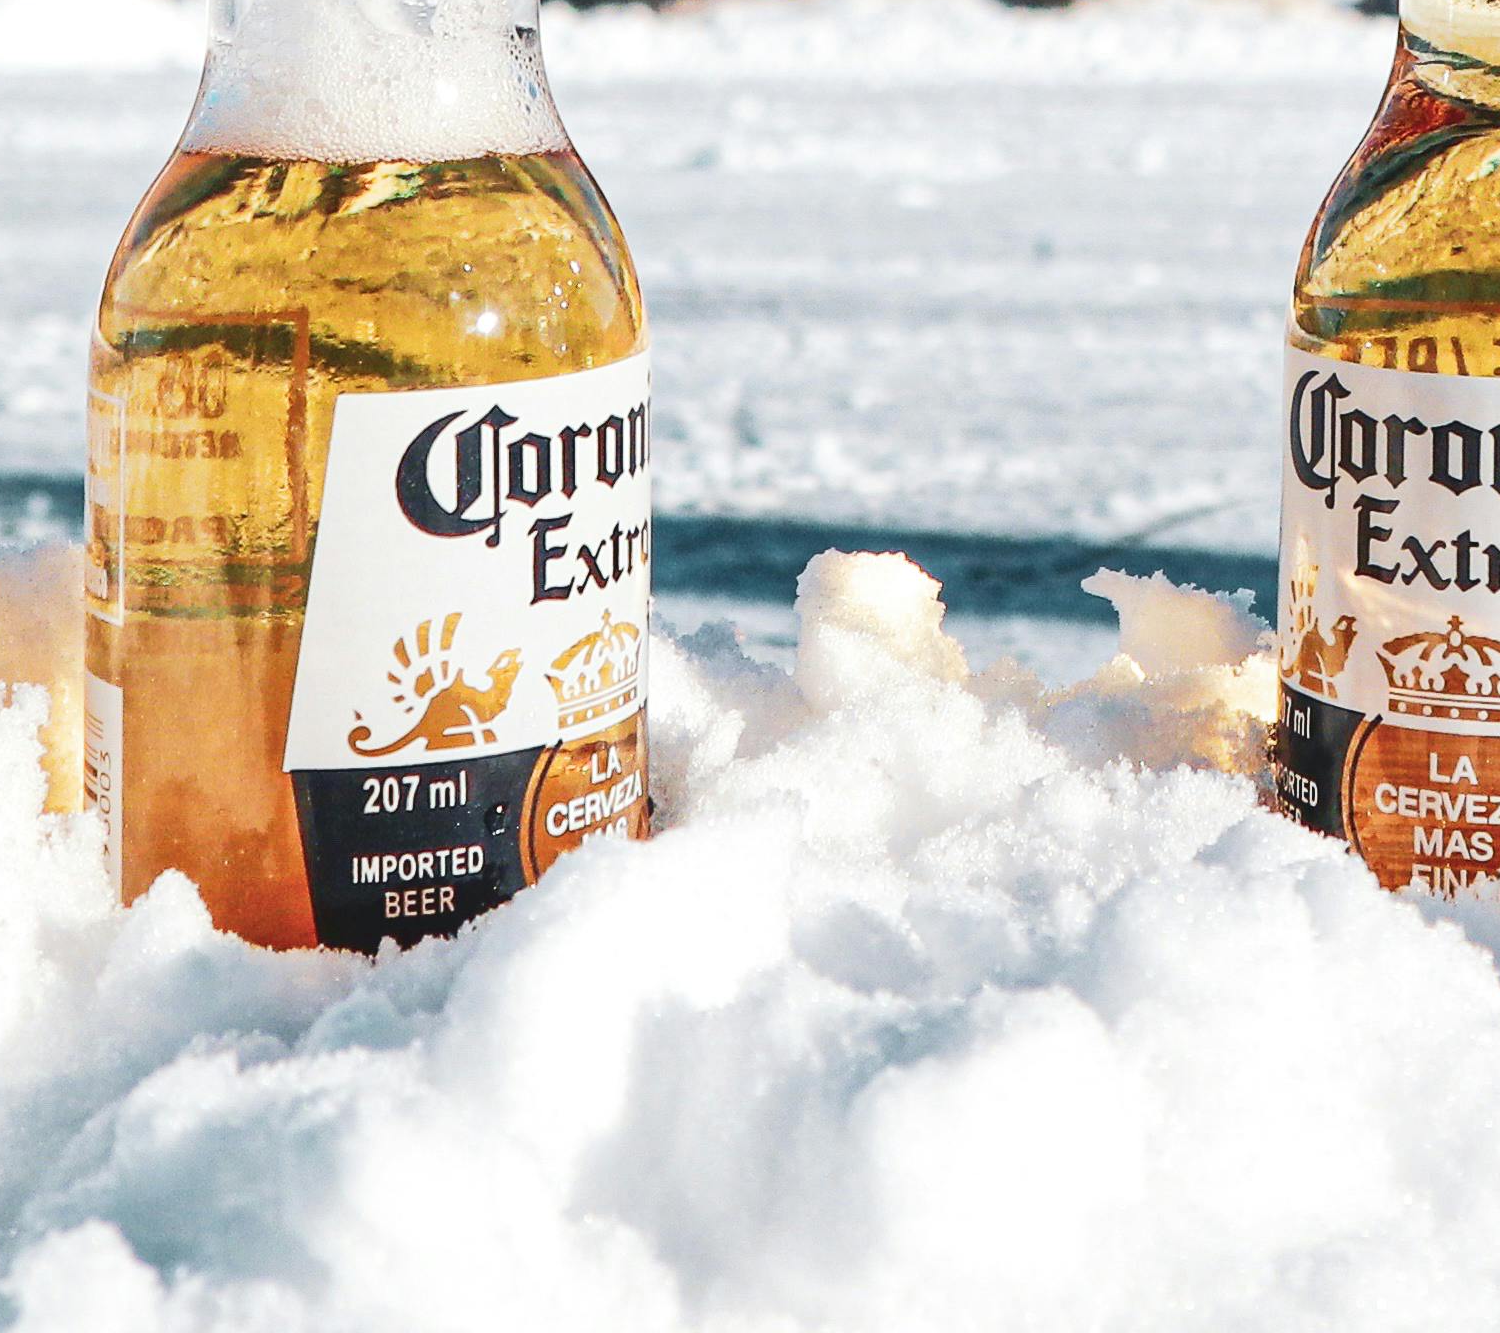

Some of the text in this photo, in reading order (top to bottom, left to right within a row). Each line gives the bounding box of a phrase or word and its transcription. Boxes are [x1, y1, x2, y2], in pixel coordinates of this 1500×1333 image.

[395, 402, 651, 549] Coron
[1293, 706, 1311, 739] ml
[590, 745, 622, 784] LA
[1428, 751, 1479, 786] LA
[362, 769, 469, 815] 207 ml
[545, 769, 643, 837] CERVEZA
[1412, 826, 1495, 862] MAS
[352, 844, 485, 884] IMPORTED
[384, 885, 456, 919] BEER
